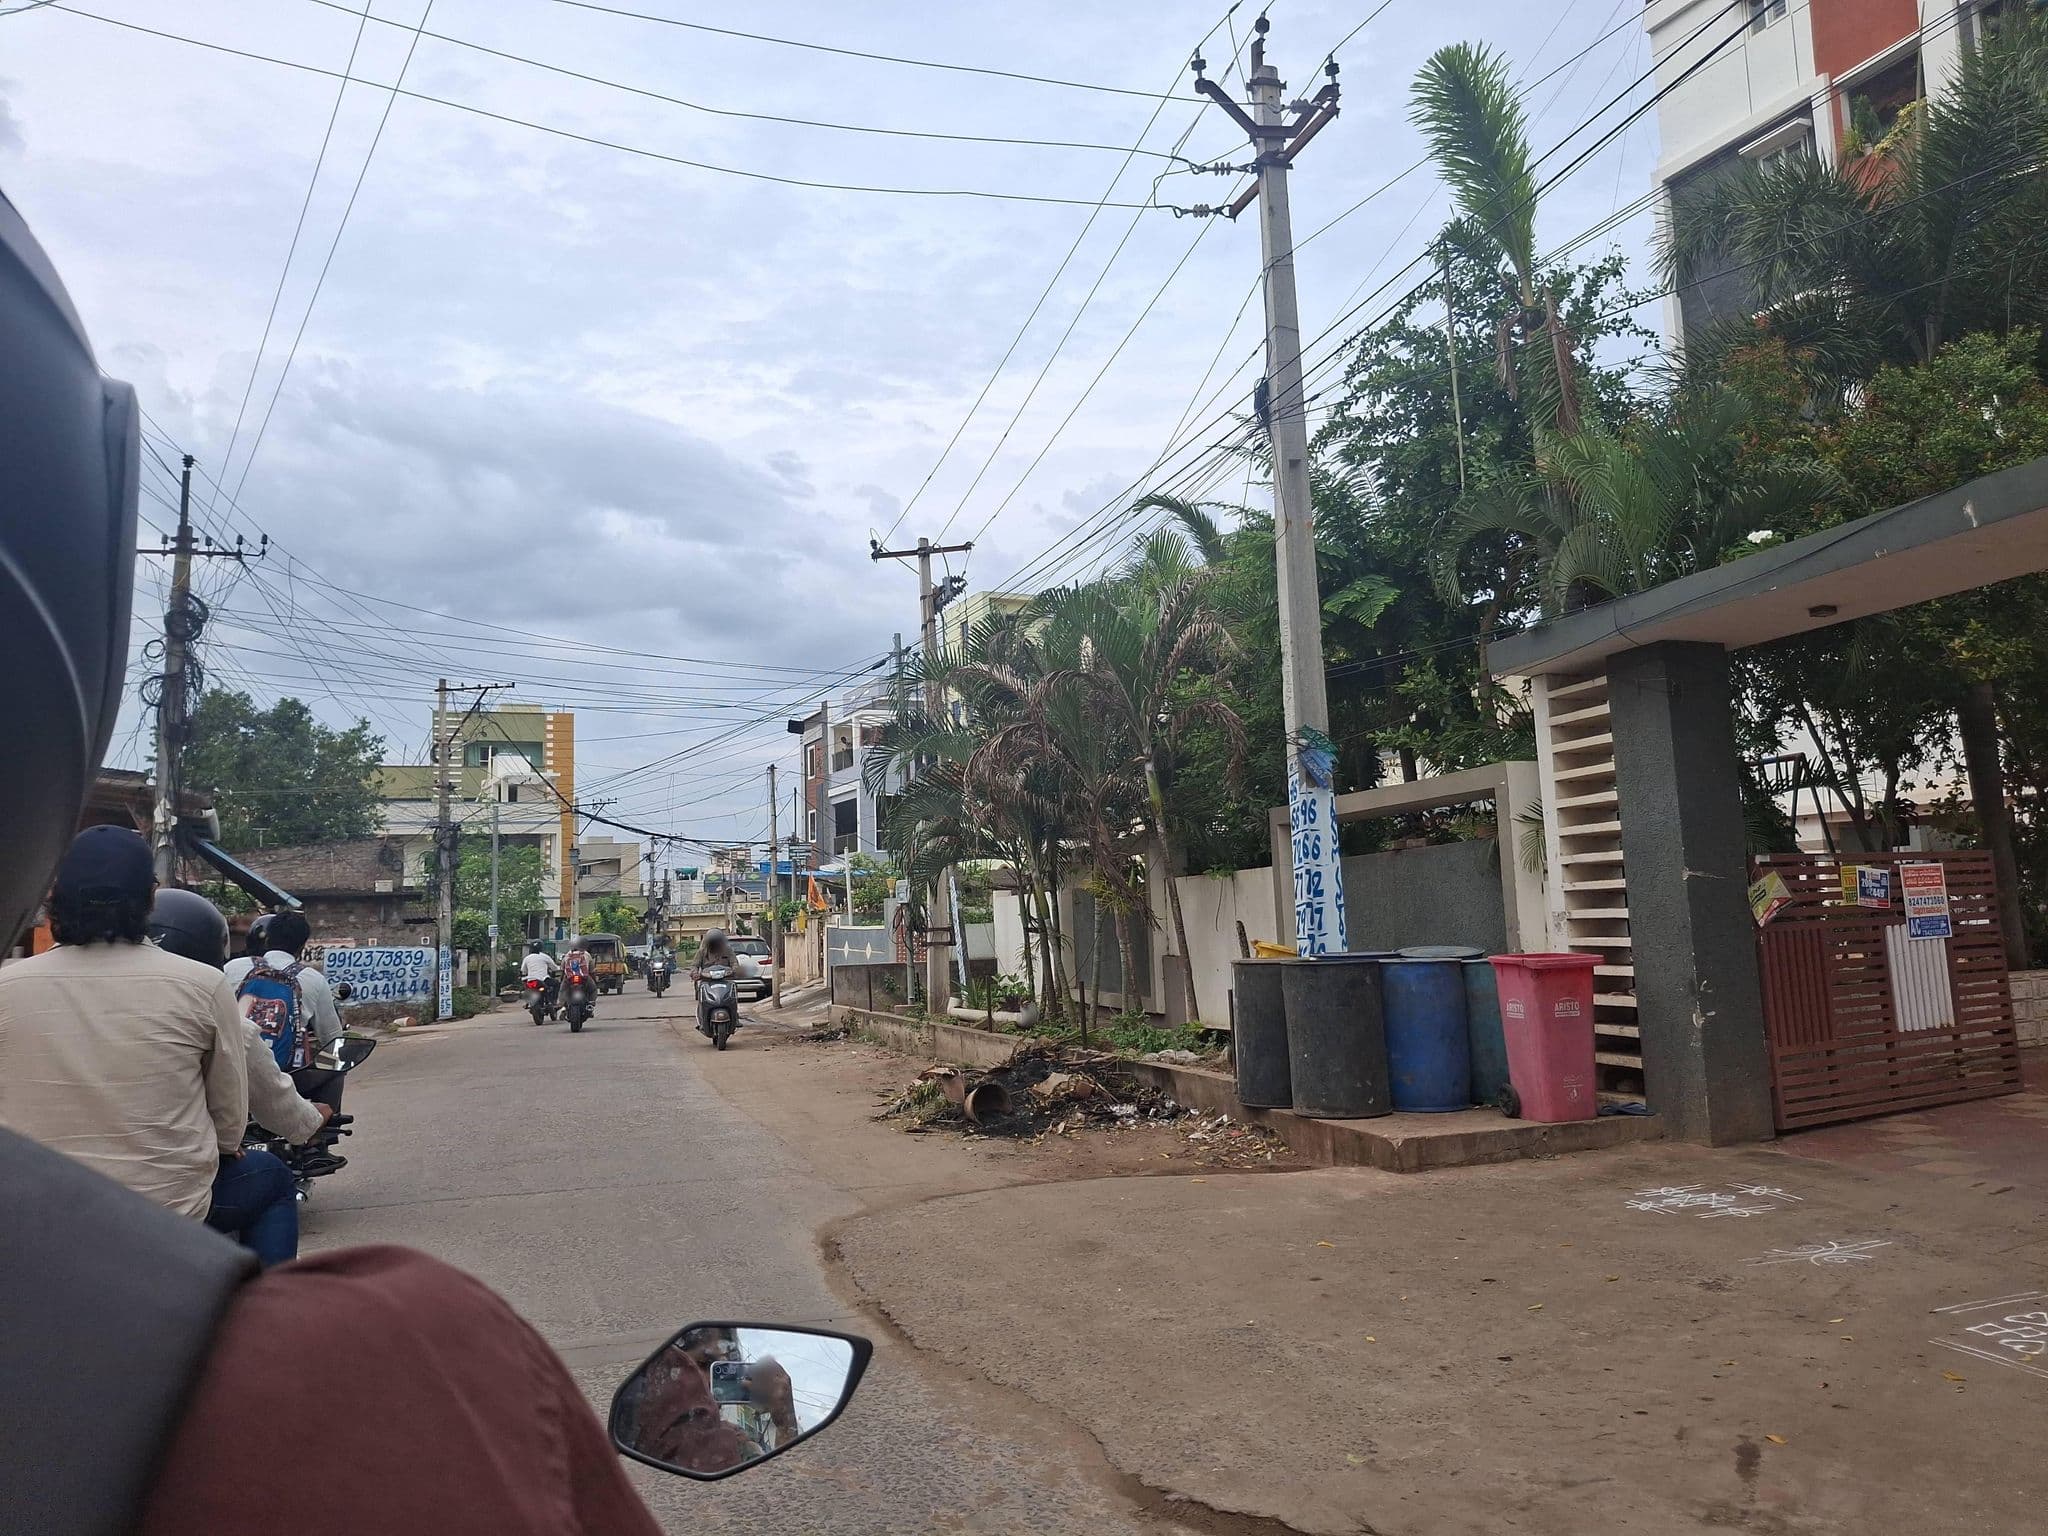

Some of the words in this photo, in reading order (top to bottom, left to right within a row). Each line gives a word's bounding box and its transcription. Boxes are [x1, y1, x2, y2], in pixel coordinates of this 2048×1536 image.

[1301, 798, 1317, 825] 96
[1302, 833, 1321, 860] 66
[1305, 869, 1325, 898] 72
[327, 950, 424, 968] 9912373839
[1554, 1001, 1580, 1012] ARISTO
